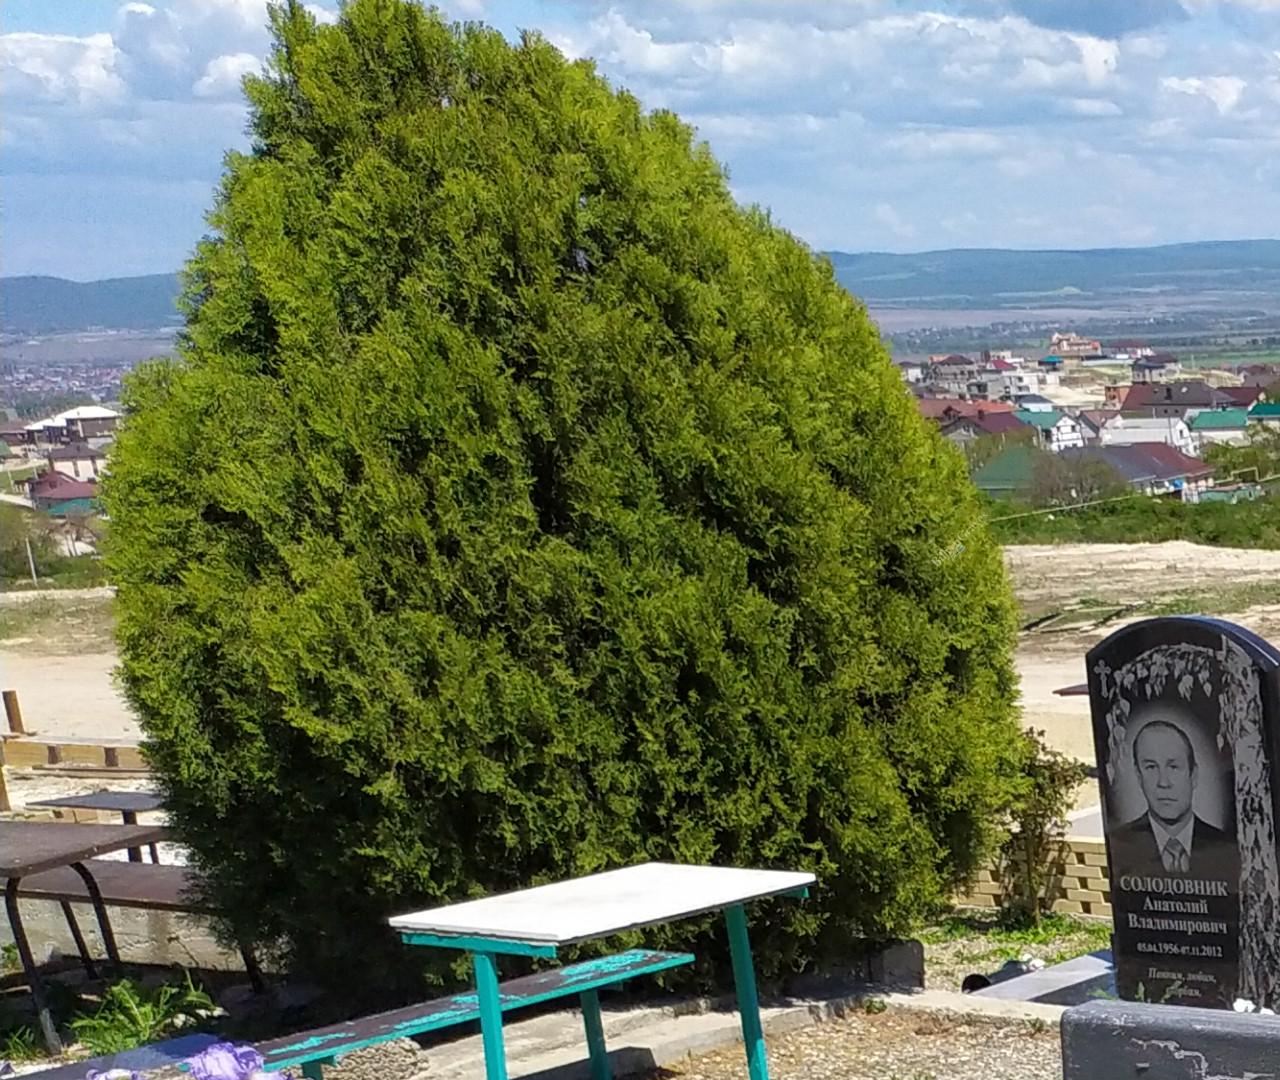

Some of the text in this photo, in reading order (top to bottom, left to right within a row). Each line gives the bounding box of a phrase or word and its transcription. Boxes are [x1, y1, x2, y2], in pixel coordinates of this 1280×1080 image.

[1120, 876, 1228, 896] СОЛОДОВНИК
[1143, 898, 1208, 913] Анатолий
[1129, 913, 1227, 935] Владимирович
